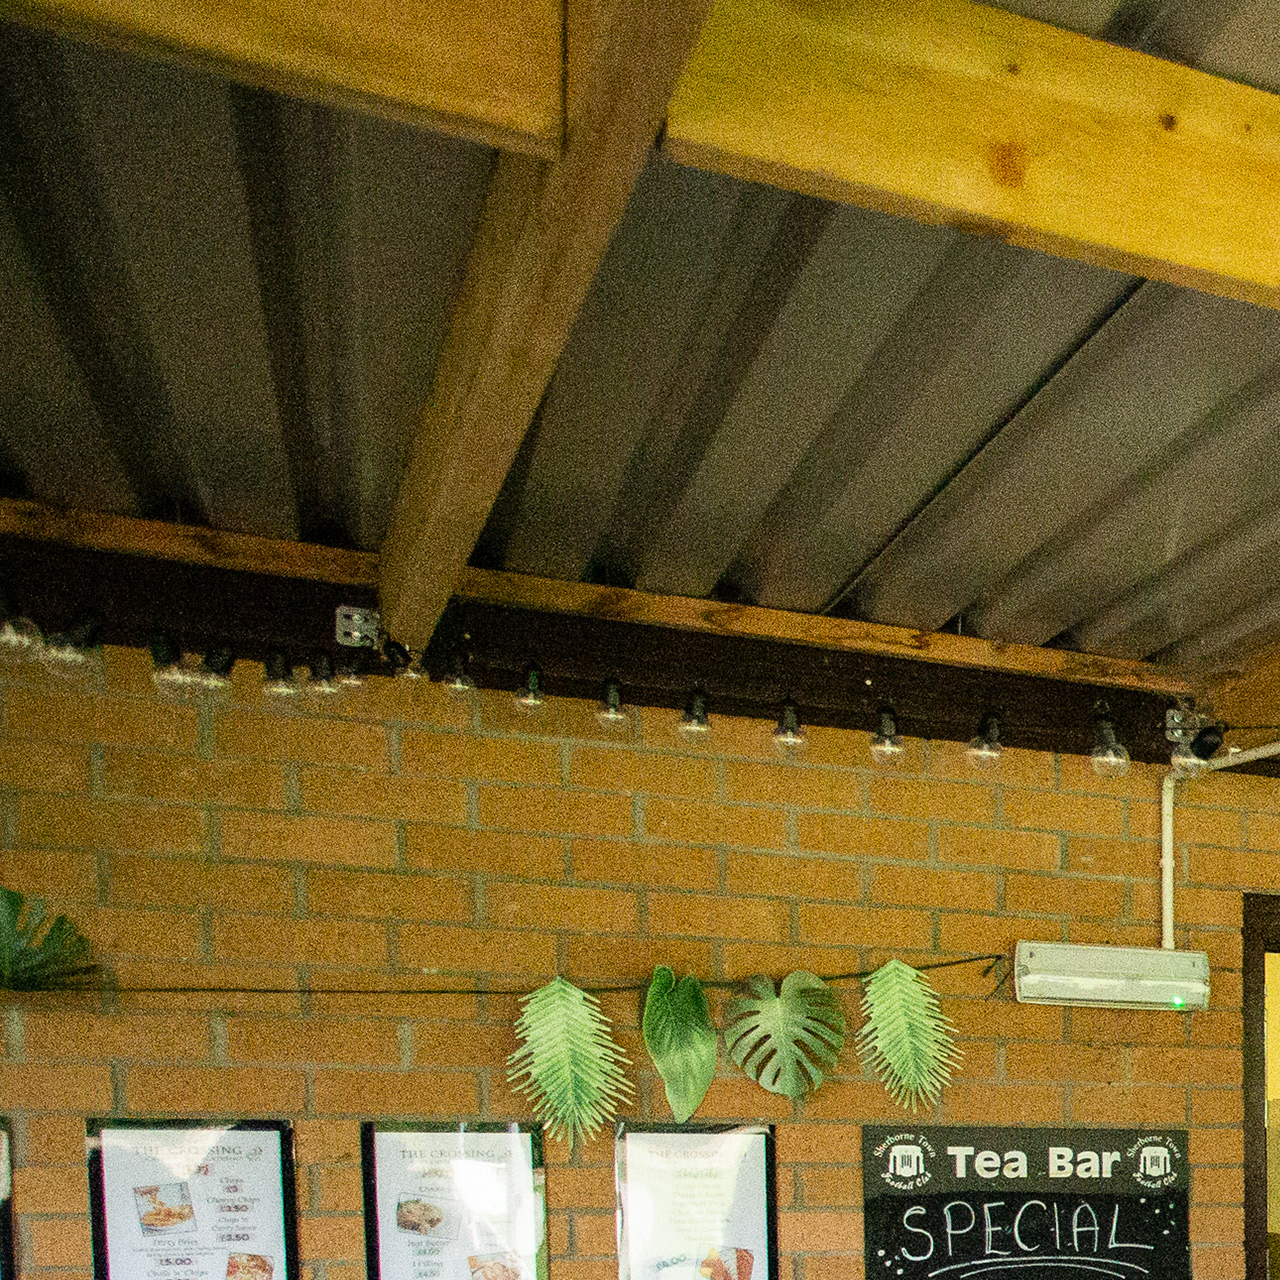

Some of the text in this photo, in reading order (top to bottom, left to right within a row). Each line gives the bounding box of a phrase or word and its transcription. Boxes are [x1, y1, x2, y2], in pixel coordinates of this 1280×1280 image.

[400, 1149, 495, 1159] THE CROSSING
[873, 1133, 937, 1158] Sherborne Town
[1126, 1136, 1182, 1159] Sherborne Town
[946, 1146, 1121, 1179] Tea Bar
[901, 1200, 1154, 1261] SPECIAL
